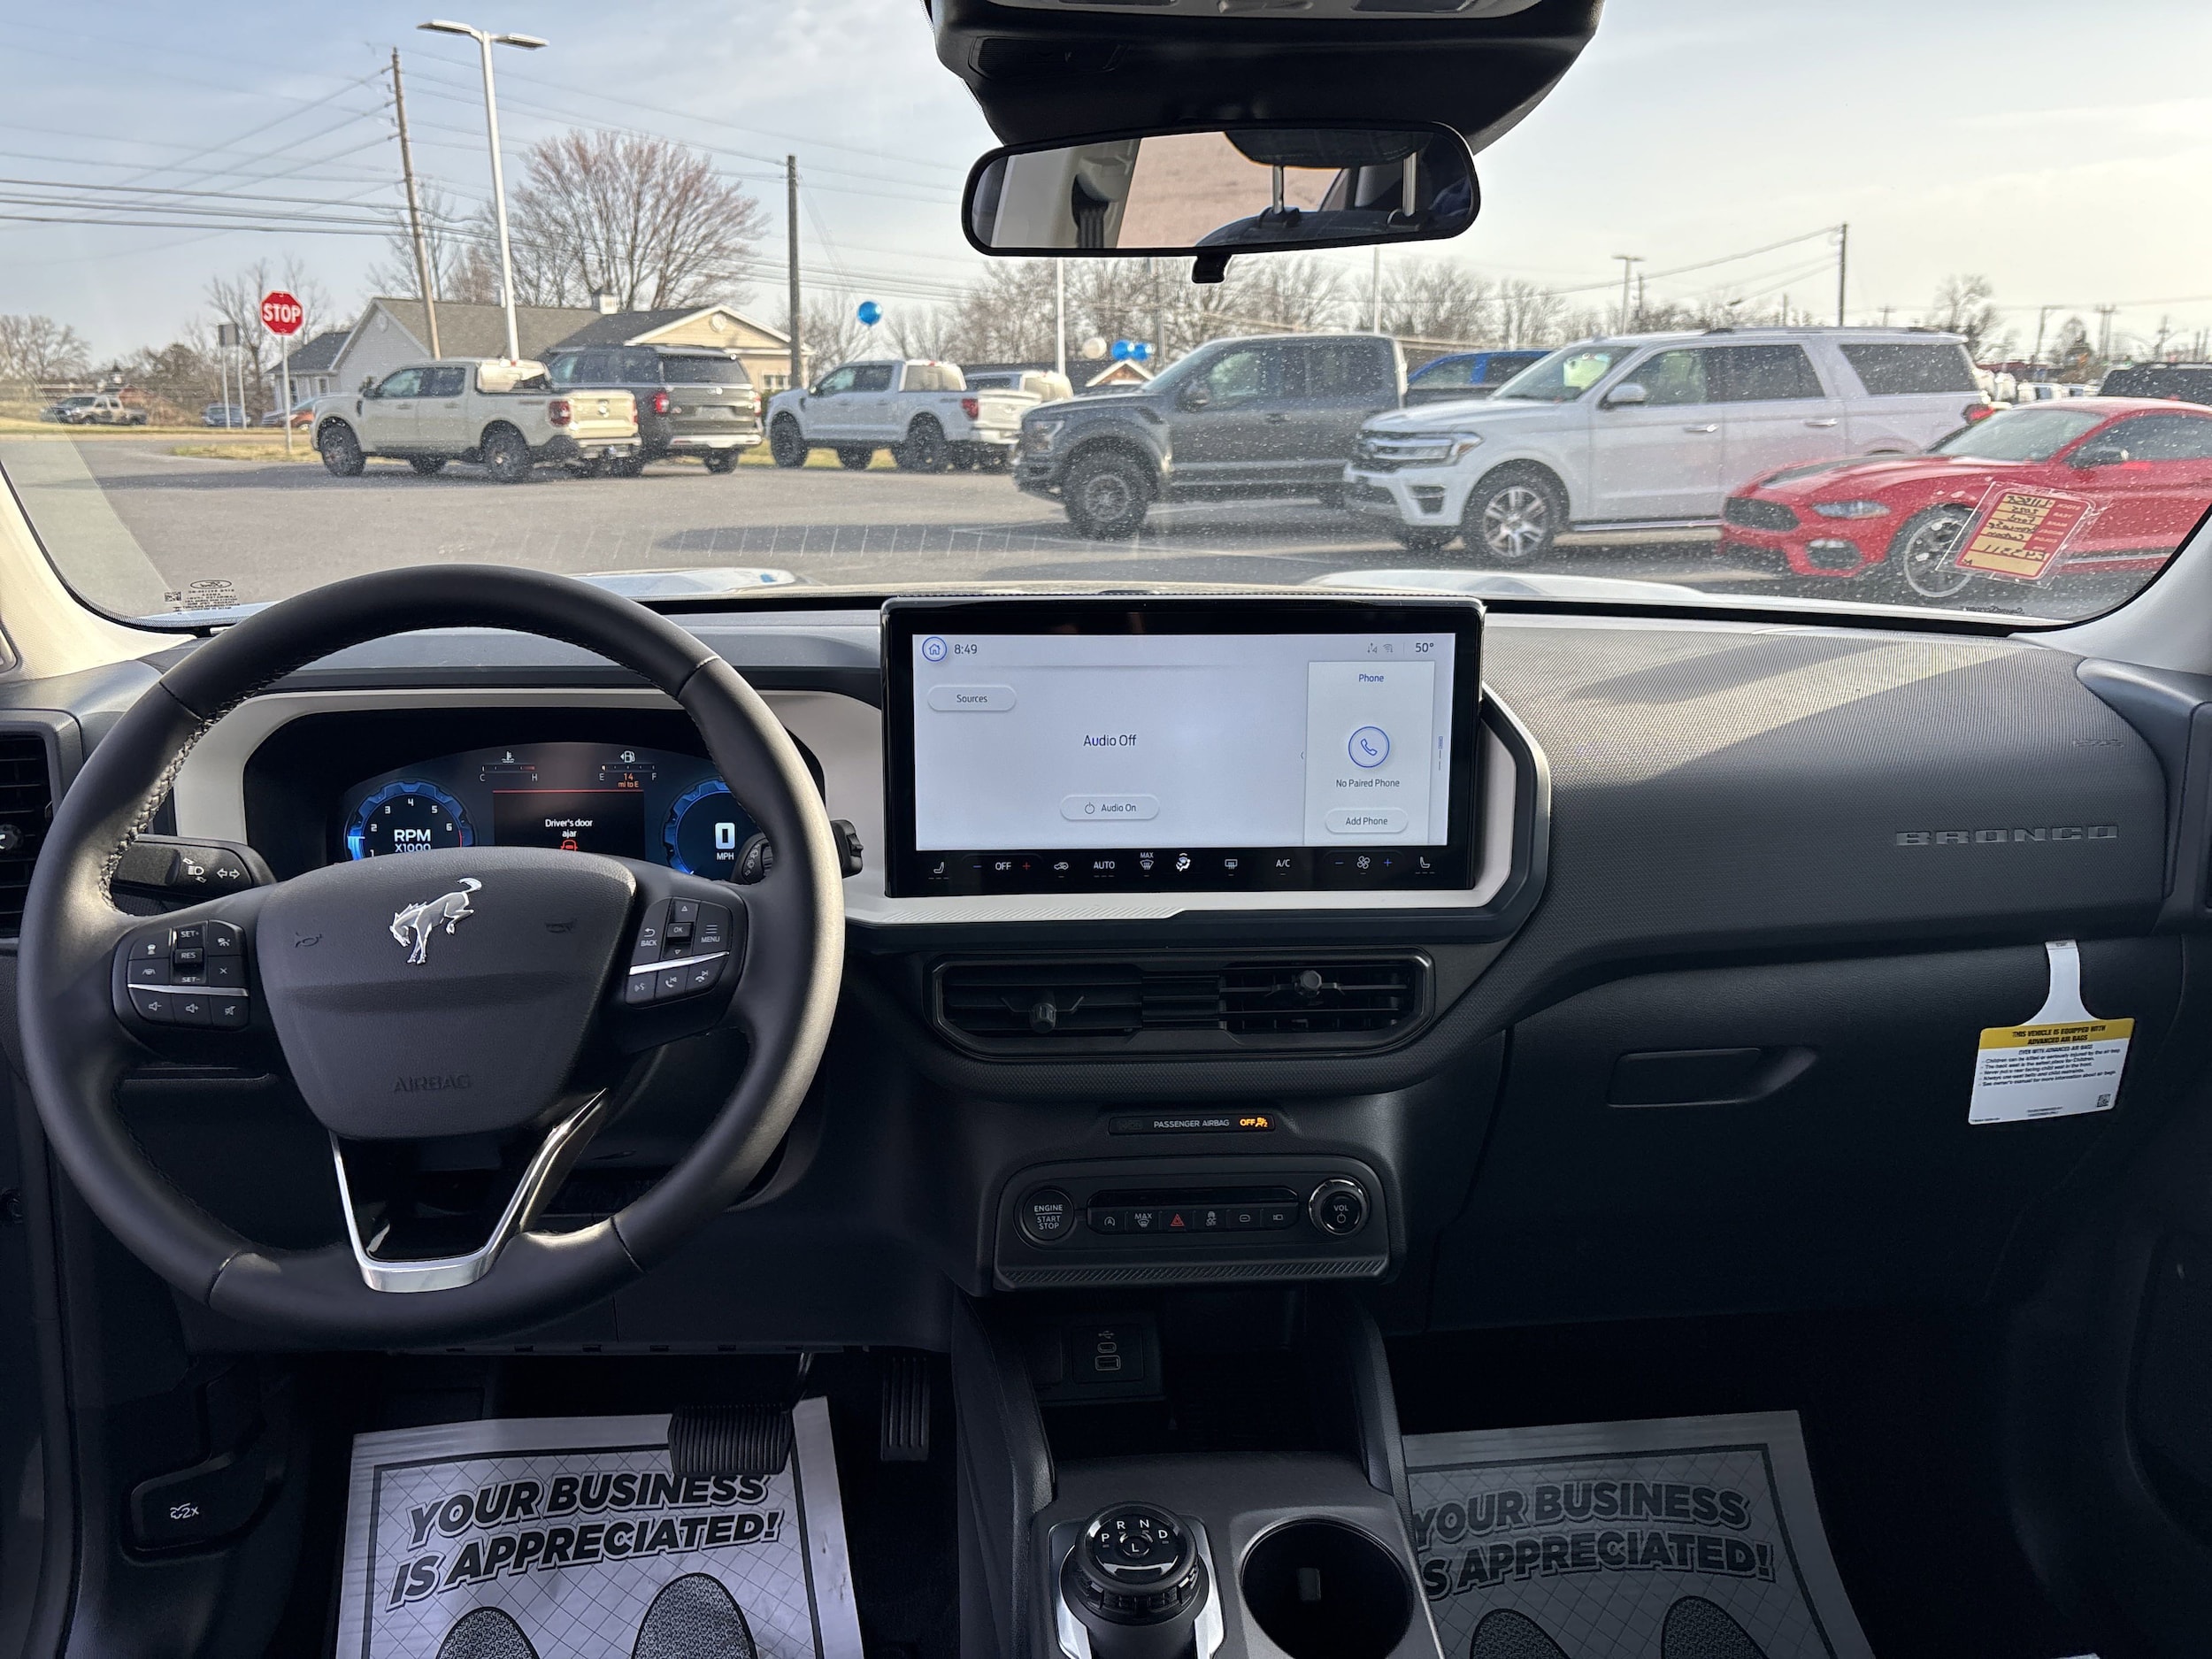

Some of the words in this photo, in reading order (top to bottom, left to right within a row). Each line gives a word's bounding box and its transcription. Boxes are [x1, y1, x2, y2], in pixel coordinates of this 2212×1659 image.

[263, 303, 302, 323] STOP
[954, 644, 978, 655] 8:49
[1415, 642, 1434, 653] 50°
[1358, 673, 1384, 682] Phone
[956, 694, 987, 703] Sources
[1083, 734, 1117, 747] Audio
[1118, 734, 1137, 747] Off
[480, 773, 486, 782] C
[1336, 779, 1347, 787] No
[1348, 779, 1373, 787] Paired
[1374, 779, 1400, 787] Phone
[384, 805, 391, 814] 3
[1101, 803, 1124, 812] Audio
[1125, 803, 1137, 812] On
[545, 818, 573, 827] Driver's
[574, 818, 593, 827] door
[1345, 817, 1362, 826] Add
[1363, 817, 1387, 826] Phone
[446, 823, 453, 832] 6
[394, 828, 432, 842] RPM
[562, 829, 578, 839] ajar
[1896, 826, 2119, 846] BRONCO
[395, 843, 432, 853] X1000
[995, 862, 1012, 871] OFF
[1093, 861, 1116, 870] AUTO
[1275, 858, 1291, 868] A/C
[394, 1074, 470, 1093] AIRBAG
[1153, 1119, 1201, 1128] PASSENGER
[1202, 1118, 1230, 1127] AIRBAG
[1039, 1222, 1060, 1231] STOP
[408, 1480, 543, 1548] YOUR
[554, 1474, 768, 1513] BUSINESS
[1416, 1489, 1526, 1542] YOUR
[1535, 1482, 1749, 1526] BUSINESS
[1116, 1521, 1125, 1530] R
[1140, 1519, 1149, 1528] N
[1101, 1533, 1110, 1542] P
[1158, 1530, 1168, 1539] D
[1132, 1543, 1140, 1552] L
[390, 1555, 442, 1604] IS
[448, 1512, 780, 1585] APPRECIATED!
[1422, 1559, 1451, 1595] S
[1459, 1531, 1773, 1587] APPRECIATED!
